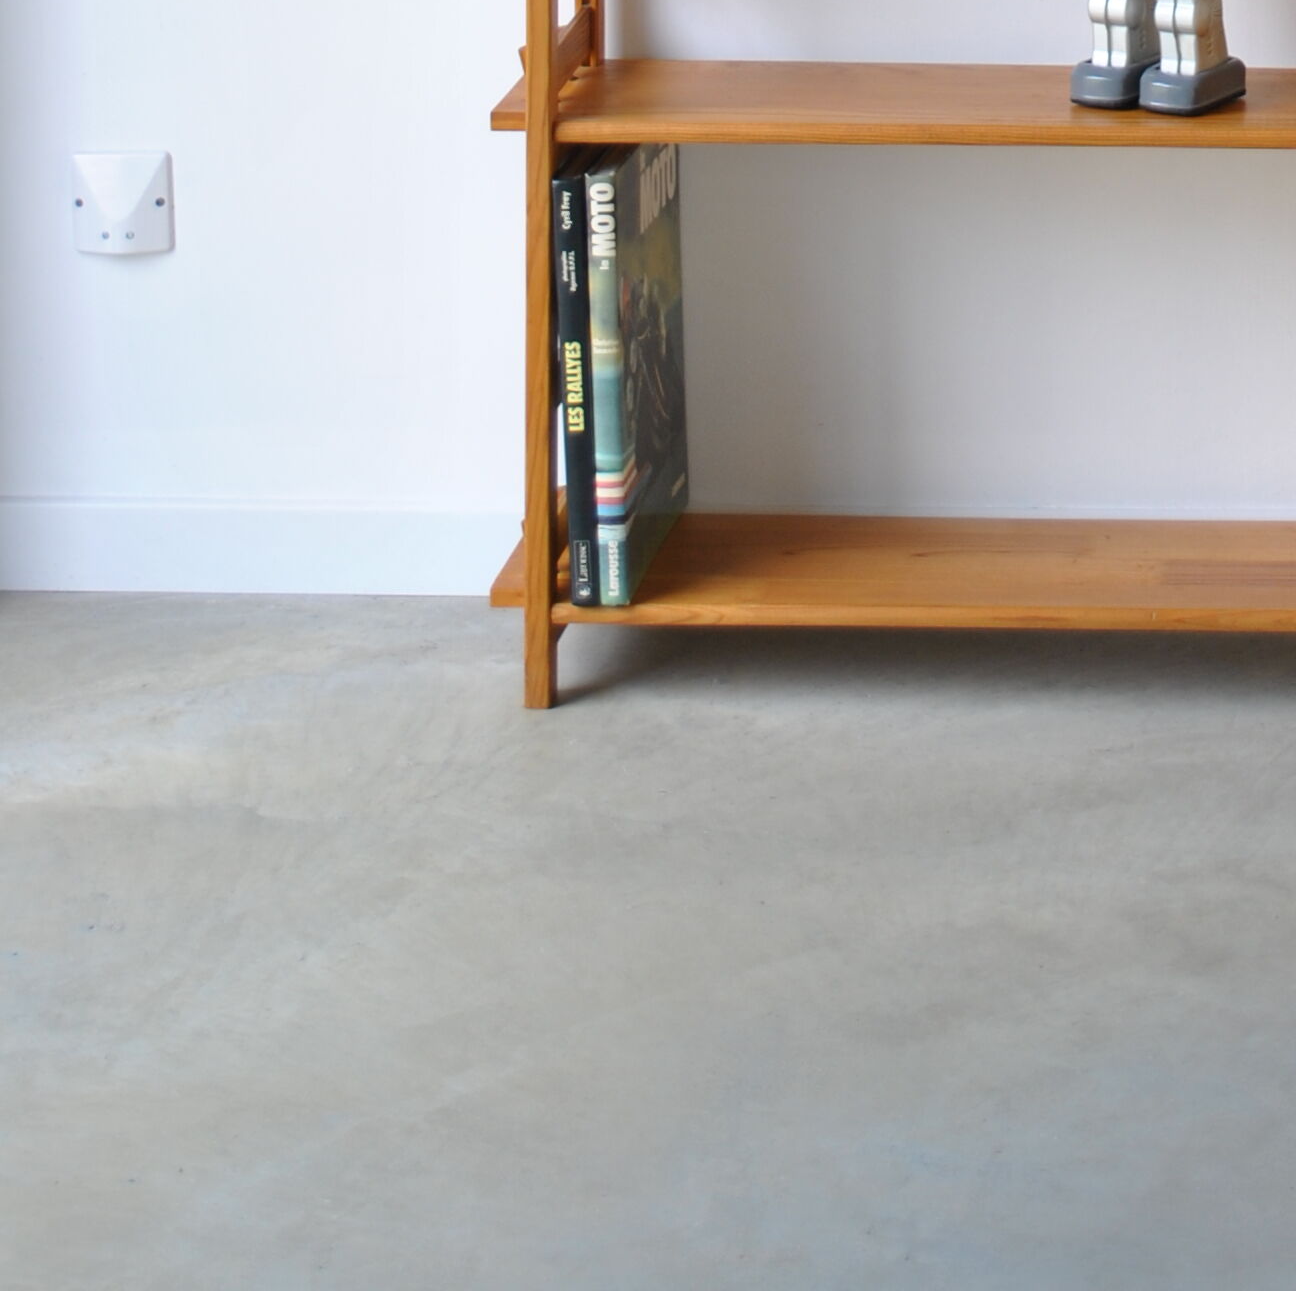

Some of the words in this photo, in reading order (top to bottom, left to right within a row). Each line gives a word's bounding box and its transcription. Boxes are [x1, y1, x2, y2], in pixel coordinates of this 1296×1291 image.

[589, 182, 616, 257] MOTO
[564, 341, 584, 404] RALLYES
[567, 406, 585, 432] LES
[608, 539, 620, 596] Larousse
